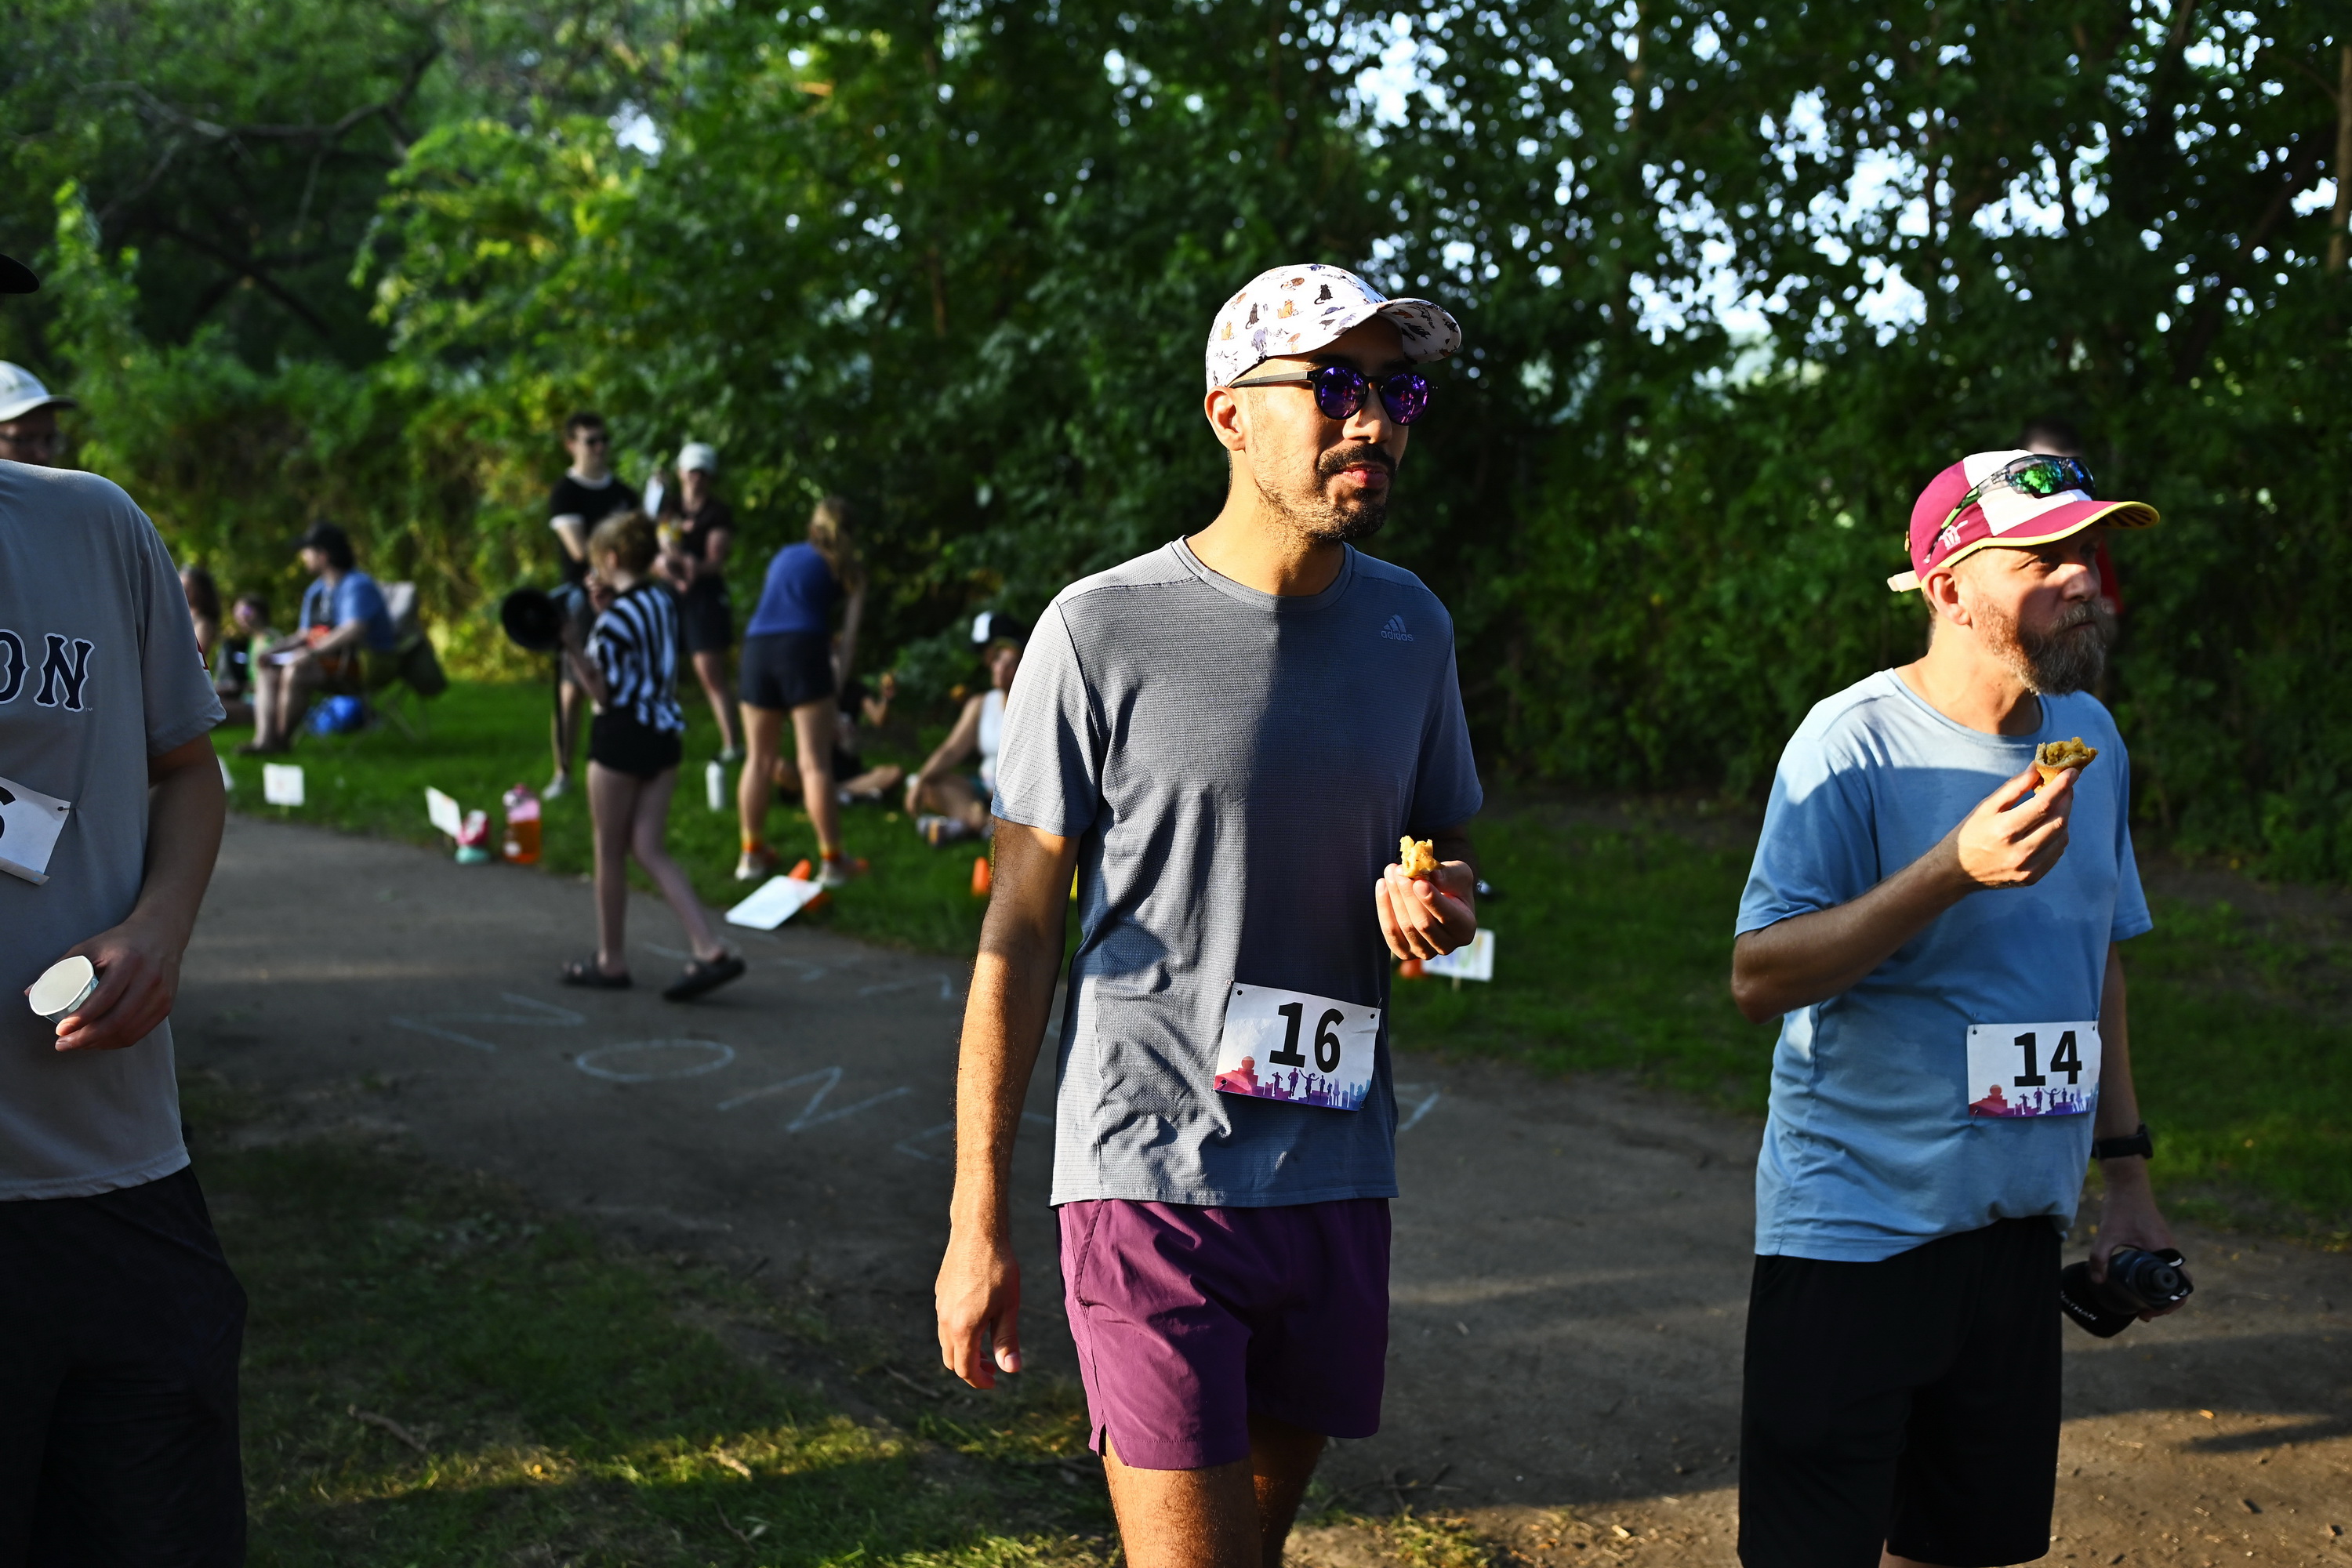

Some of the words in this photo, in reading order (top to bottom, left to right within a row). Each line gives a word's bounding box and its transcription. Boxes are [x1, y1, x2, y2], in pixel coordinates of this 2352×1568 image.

[1381, 630, 1414, 642] adidas
[1269, 1001, 1345, 1073] 16
[2014, 1030, 2082, 1087] 14
